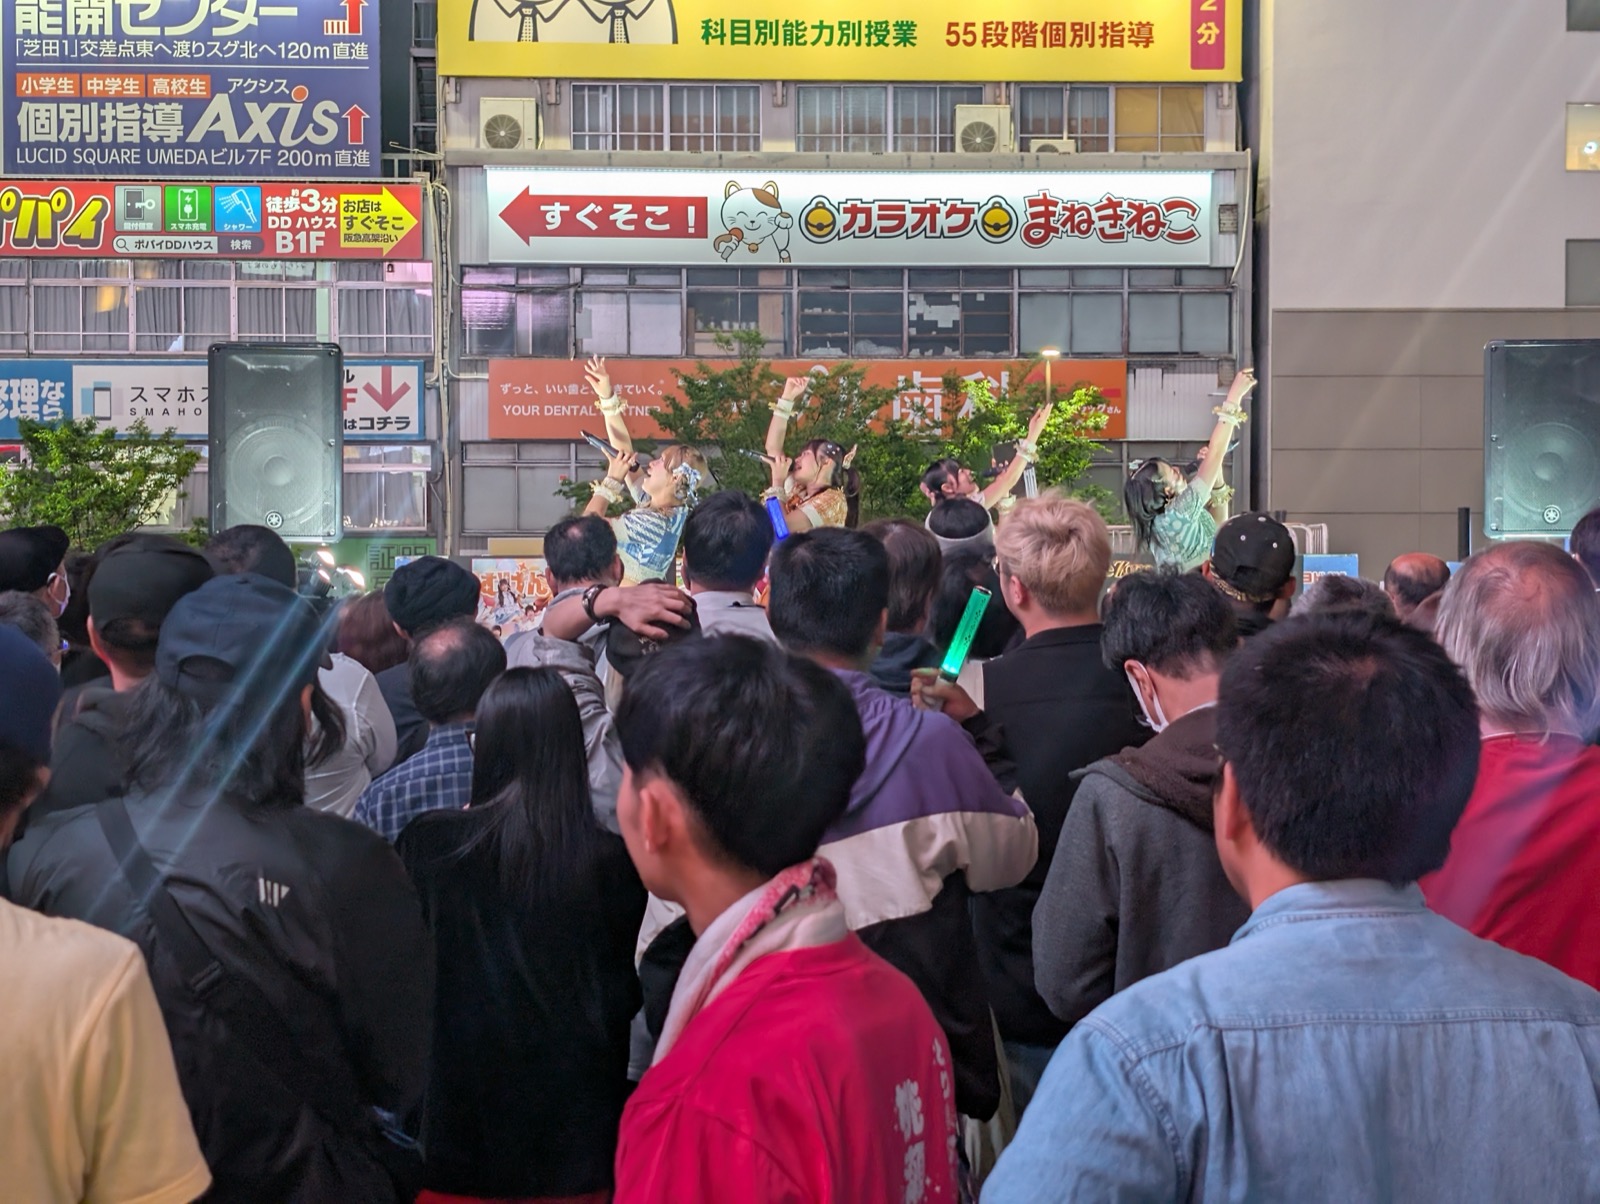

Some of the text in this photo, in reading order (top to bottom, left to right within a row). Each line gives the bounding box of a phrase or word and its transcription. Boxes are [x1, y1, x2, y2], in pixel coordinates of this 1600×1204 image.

[701, 18, 1155, 49] 科目別能力別授業 55段階個別指導
[21, 77, 207, 96] 小学生 中学生 高校生
[227, 78, 290, 95] アクシス
[17, 85, 341, 147] 個別指導 Axis
[16, 148, 67, 164] LUCID
[73, 148, 142, 166] SQUARE
[265, 189, 339, 214] 徒歩3分
[343, 199, 382, 214] お店は
[0, 186, 109, 250] パイ
[267, 217, 338, 230] DD ハウス
[343, 215, 405, 231] すぐそこ
[840, 201, 977, 236] カラオケ
[1021, 190, 1200, 248] まねきねこ
[170, 222, 208, 231] スマホ充電
[223, 223, 253, 232] シャワー
[230, 239, 252, 251] 検索
[275, 231, 326, 254] B1F
[343, 233, 400, 244] 阪急高架沿い
[500, 382, 663, 396] ずっと、いい歯と、きていく。
[502, 404, 541, 416] YOUR
[543, 404, 597, 416] DENTAL
[344, 416, 411, 431] はコチラ
